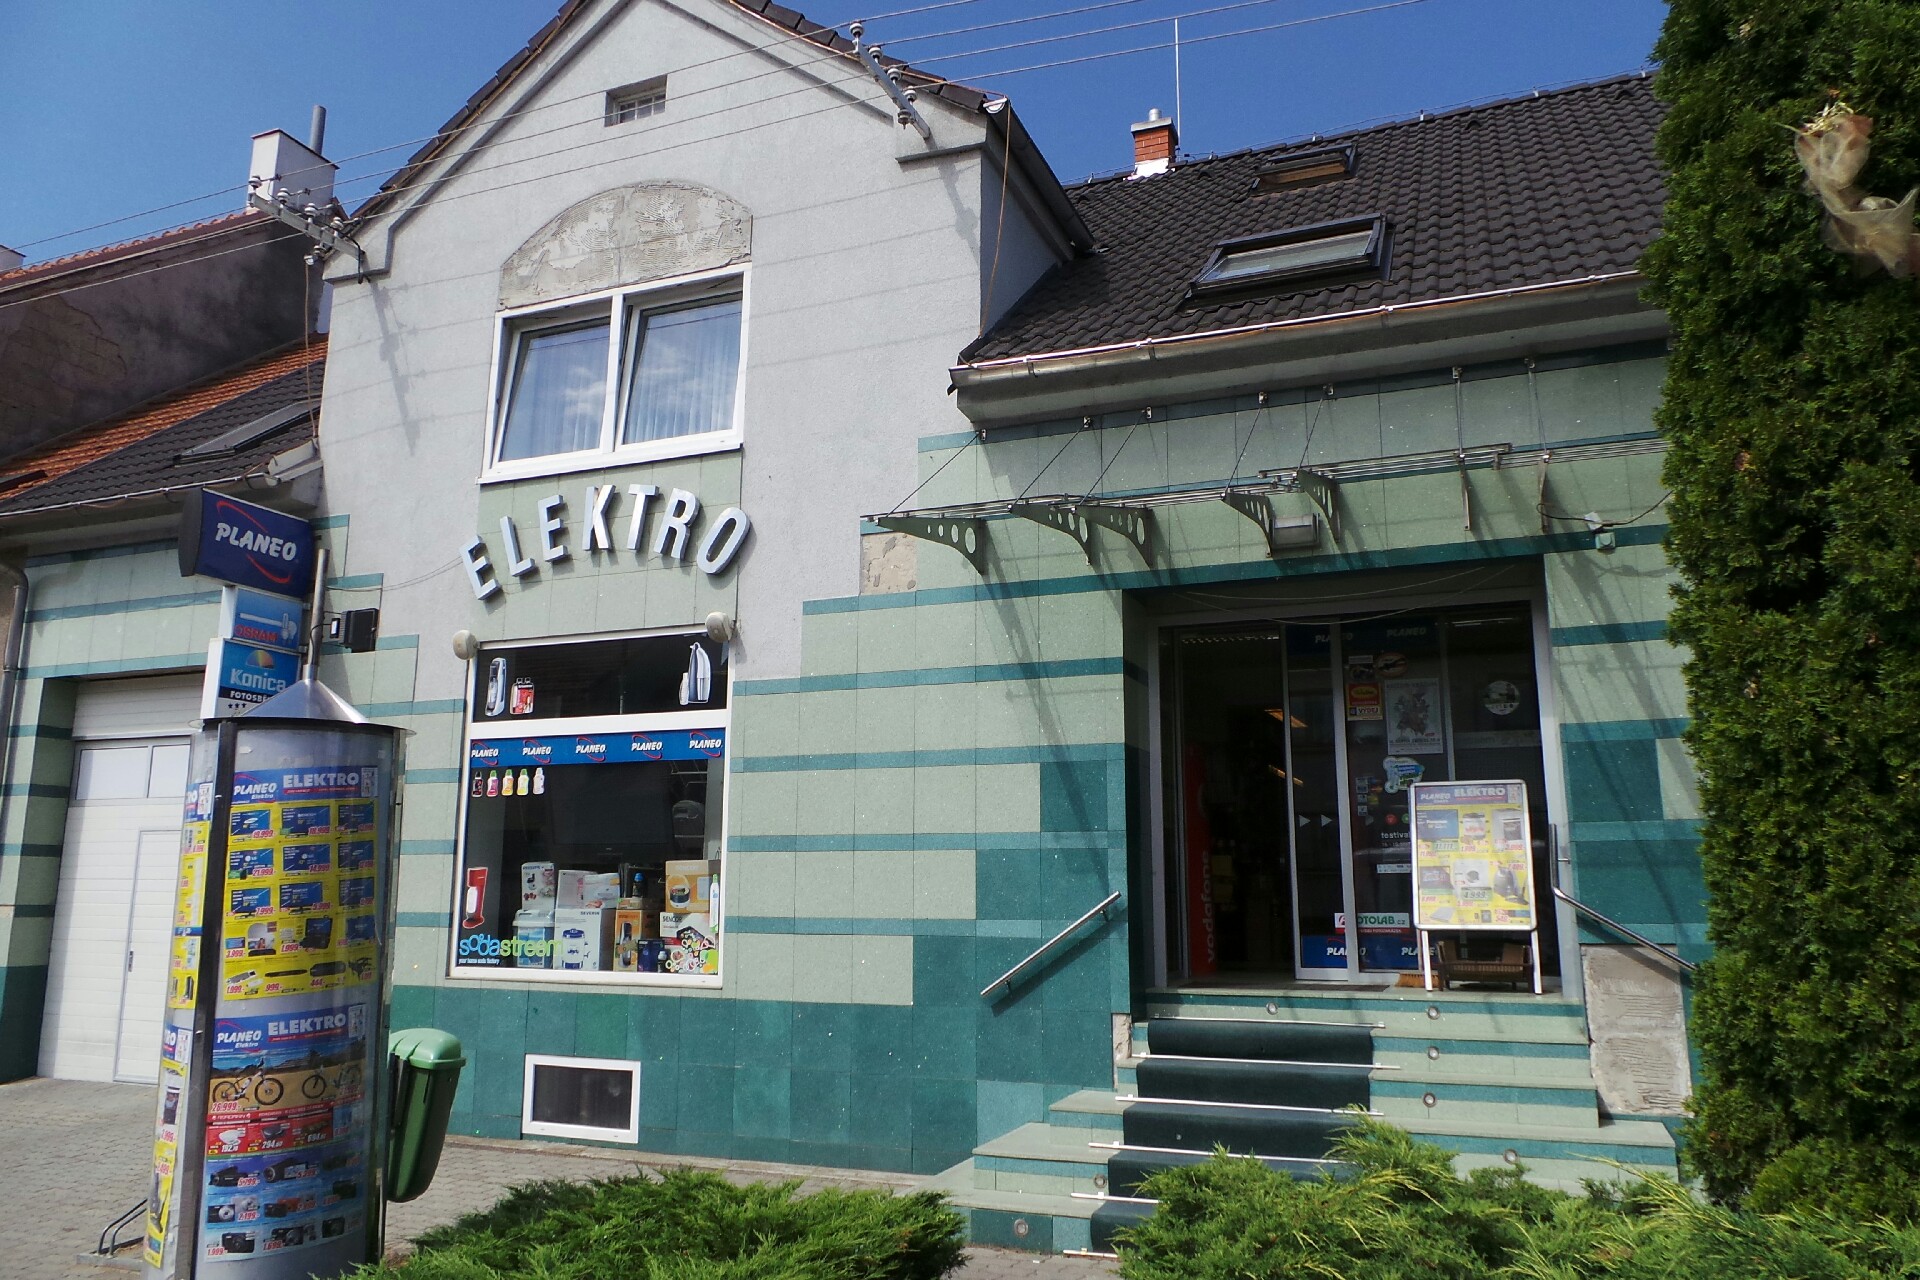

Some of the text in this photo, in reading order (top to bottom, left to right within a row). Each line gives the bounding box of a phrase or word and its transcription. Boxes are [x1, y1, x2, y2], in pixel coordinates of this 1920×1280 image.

[215, 522, 297, 561] PLANEO
[459, 484, 750, 600] ELEKTRO
[234, 624, 278, 641] OSRAM
[1387, 626, 1427, 638] PLANEO
[230, 668, 286, 691] Konica
[471, 739, 722, 758] PLANEO PLANEO PLANEO PLANEO PLANEO
[233, 782, 277, 795] PLANEO
[283, 772, 359, 788] ELEKTRO
[1420, 792, 1451, 801] PLANEO
[1454, 787, 1506, 797] ELEKTRO
[1201, 850, 1215, 964] vodafone
[459, 933, 563, 957] sodastream
[268, 1013, 346, 1036] ELEKTRO
[217, 1030, 262, 1044] PLANEO
